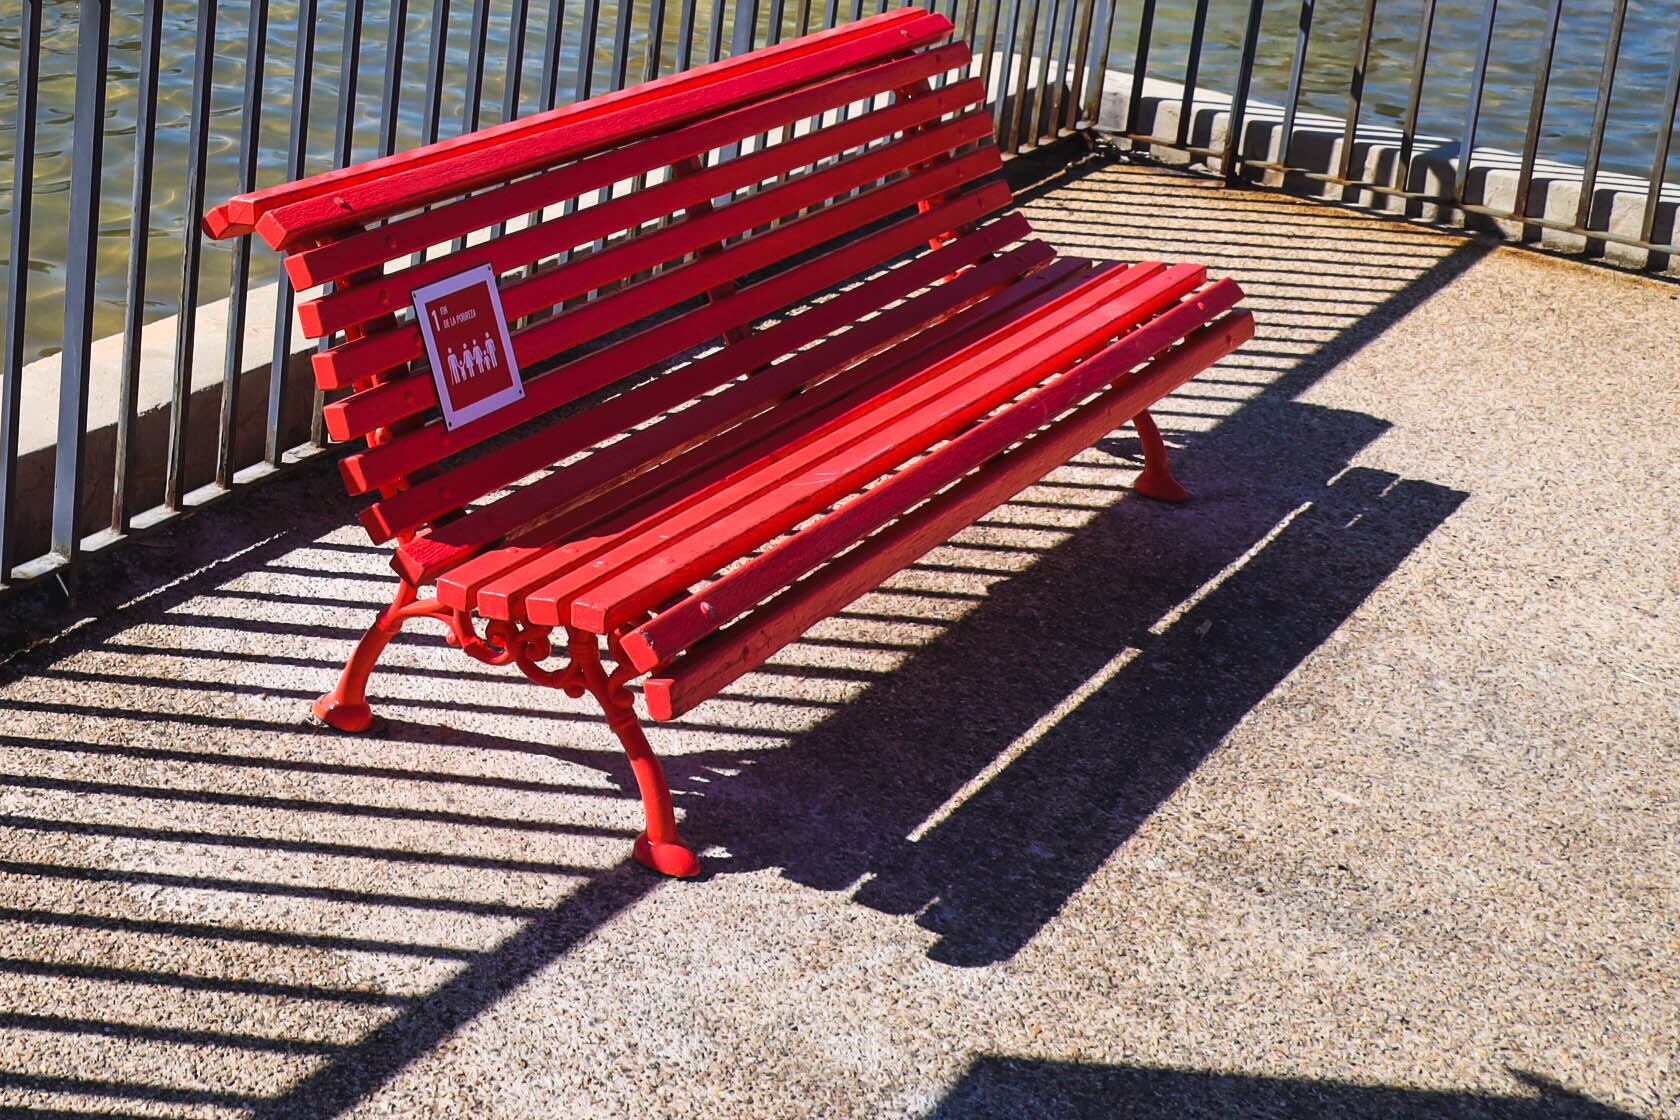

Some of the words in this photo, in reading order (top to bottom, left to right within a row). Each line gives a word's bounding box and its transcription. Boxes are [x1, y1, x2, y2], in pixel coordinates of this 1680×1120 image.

[431, 309, 441, 333] 1
[439, 305, 449, 316] FIN
[443, 318, 451, 329] DE
[449, 316, 457, 326] LA
[456, 308, 477, 325] POBREZA
